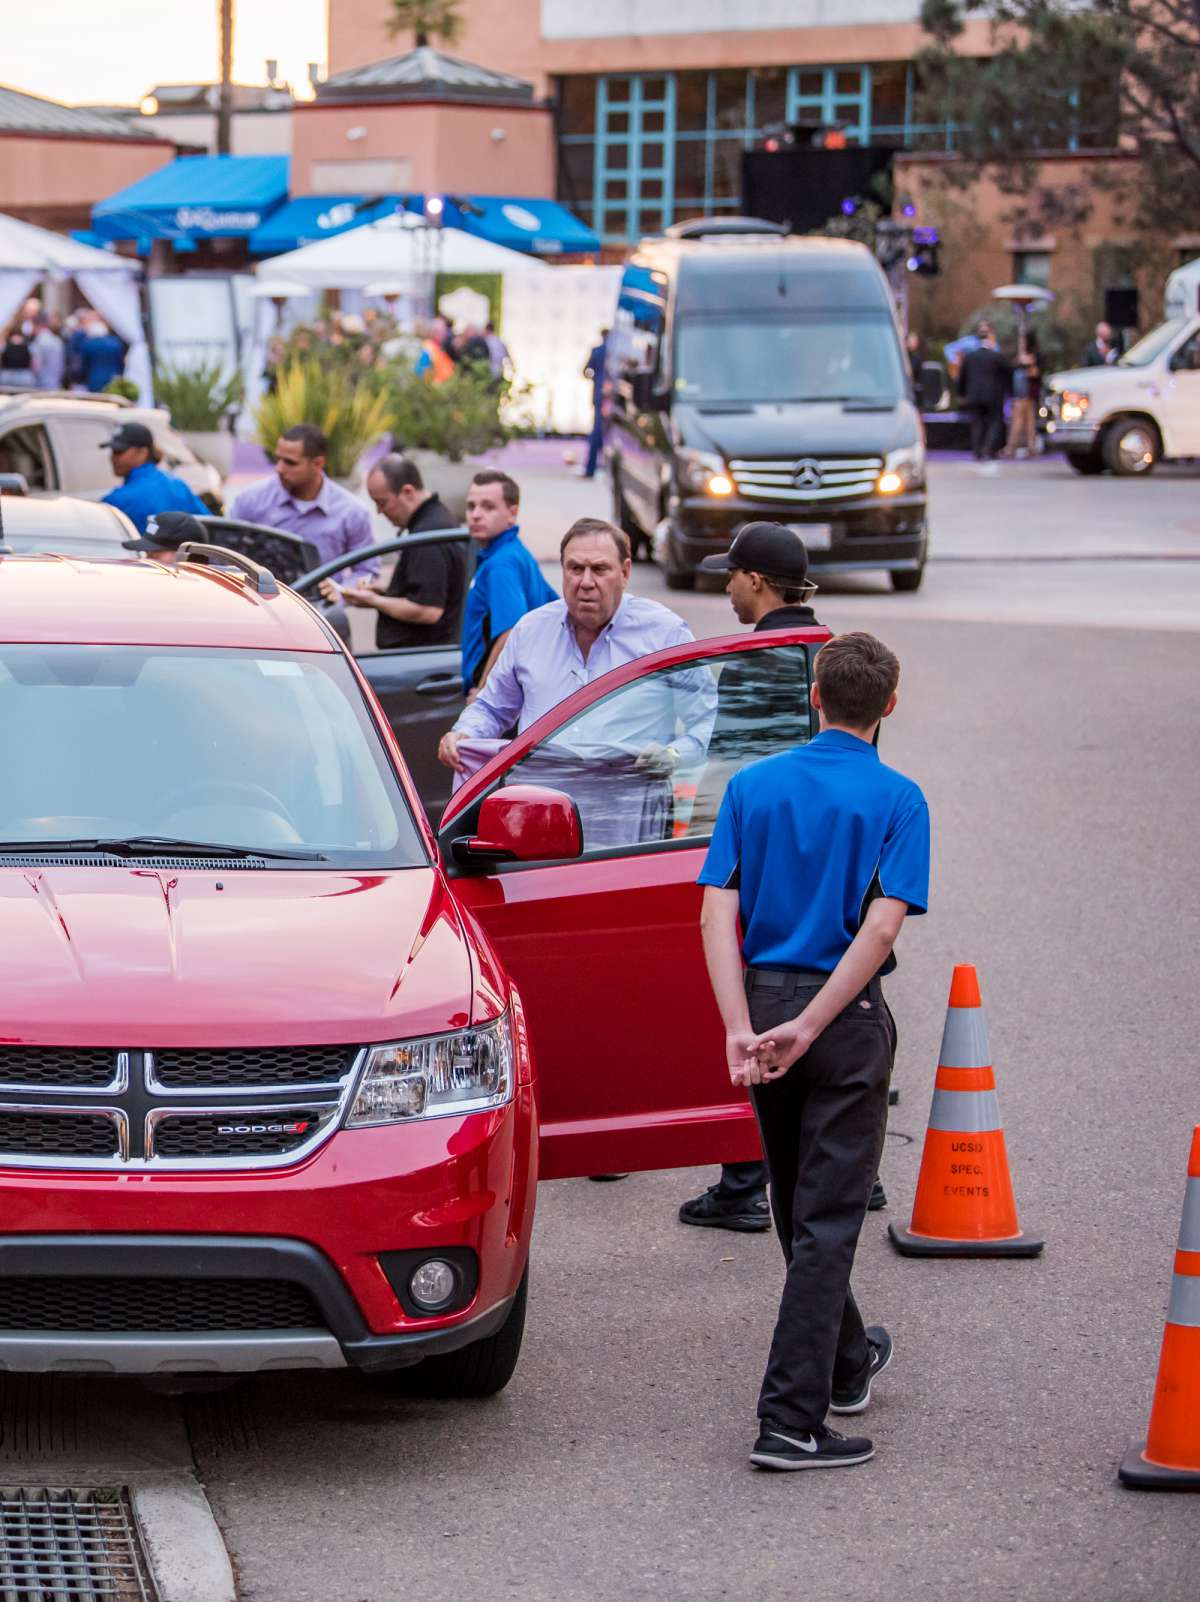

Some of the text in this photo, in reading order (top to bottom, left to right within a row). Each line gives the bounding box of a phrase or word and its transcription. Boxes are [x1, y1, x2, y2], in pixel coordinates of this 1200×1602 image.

[217, 1124, 298, 1134] DODGE
[951, 1142, 984, 1153] UCSD
[943, 1185, 989, 1198] EVENTS
